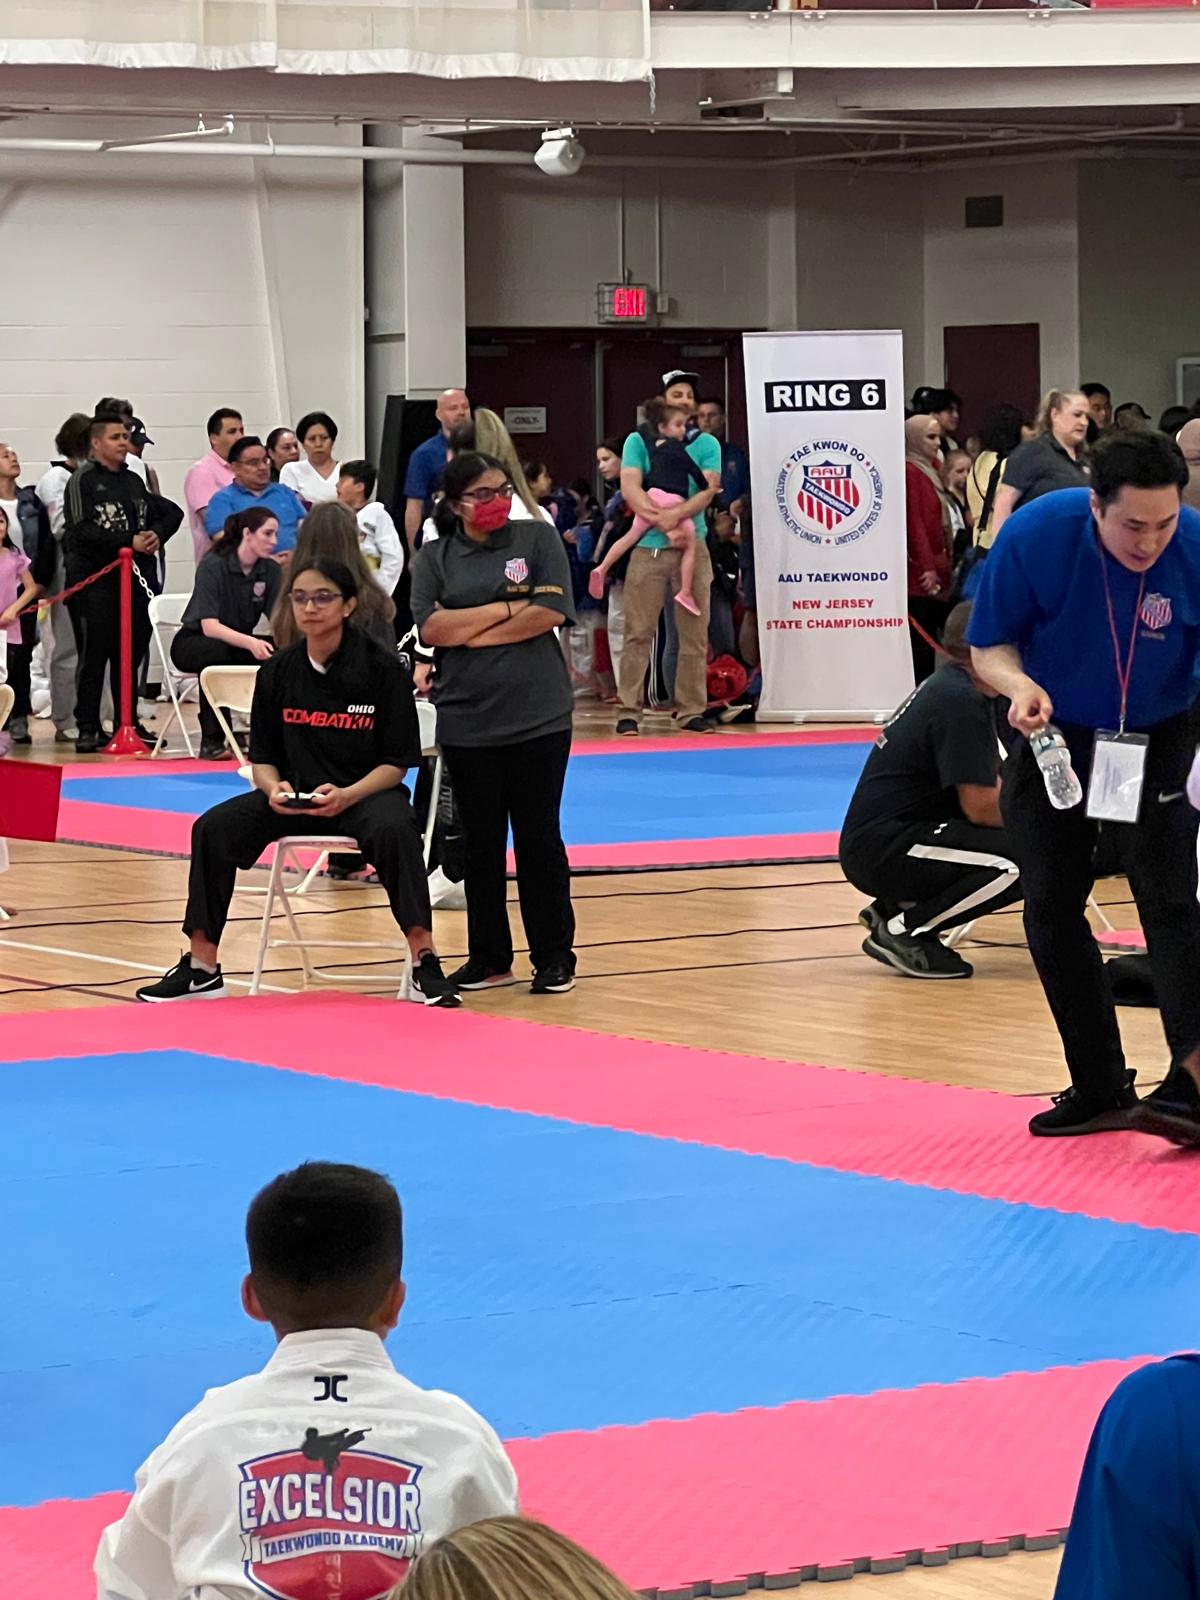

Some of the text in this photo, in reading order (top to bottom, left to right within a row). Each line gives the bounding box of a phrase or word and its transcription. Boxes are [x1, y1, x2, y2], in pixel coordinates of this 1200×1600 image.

[614, 288, 645, 316] EXIT
[772, 383, 880, 408] RING 6
[790, 440, 865, 462] TAE KWON DO
[810, 467, 844, 477] AAU
[776, 468, 822, 544] AMATEUR ATHLETIC UNION
[835, 530, 860, 545] UNITED
[858, 511, 880, 534] STATES
[873, 500, 882, 510] OF
[778, 572, 888, 583] AAU TAEKWONDO
[792, 599, 874, 610] NEW JERSEY
[766, 618, 904, 630] STATE CHAMPIONSHIP
[347, 704, 375, 714] OHIO
[240, 1473, 421, 1532] EXCELSIOR
[264, 1532, 404, 1558] TAEKWONDO ACADEMY
